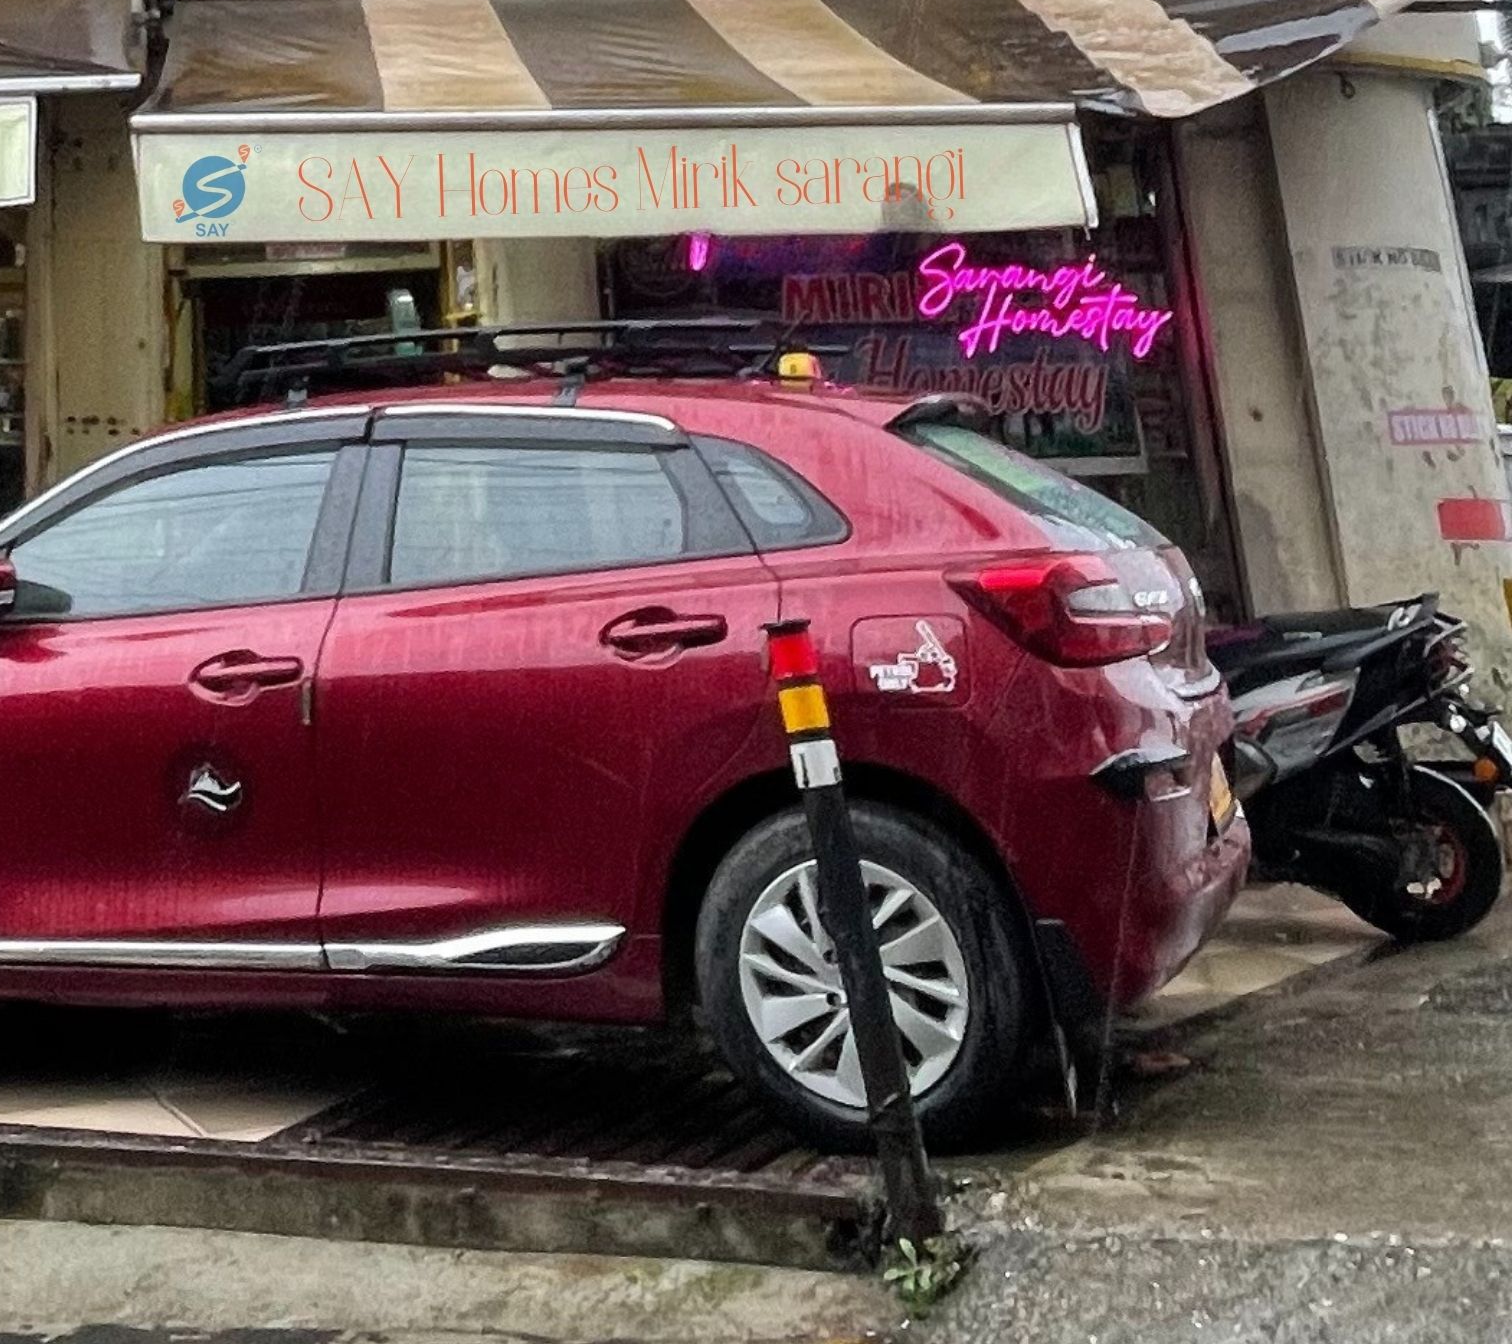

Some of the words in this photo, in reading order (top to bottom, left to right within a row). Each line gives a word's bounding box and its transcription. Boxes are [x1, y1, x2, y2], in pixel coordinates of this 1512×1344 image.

[297, 153, 416, 223] SAY
[437, 152, 619, 218] Homes
[636, 143, 758, 212] Mirik
[775, 146, 966, 221] sarangi
[195, 223, 230, 238] SAY
[918, 241, 1107, 316] Sarangi
[957, 280, 1175, 360] Homestay
